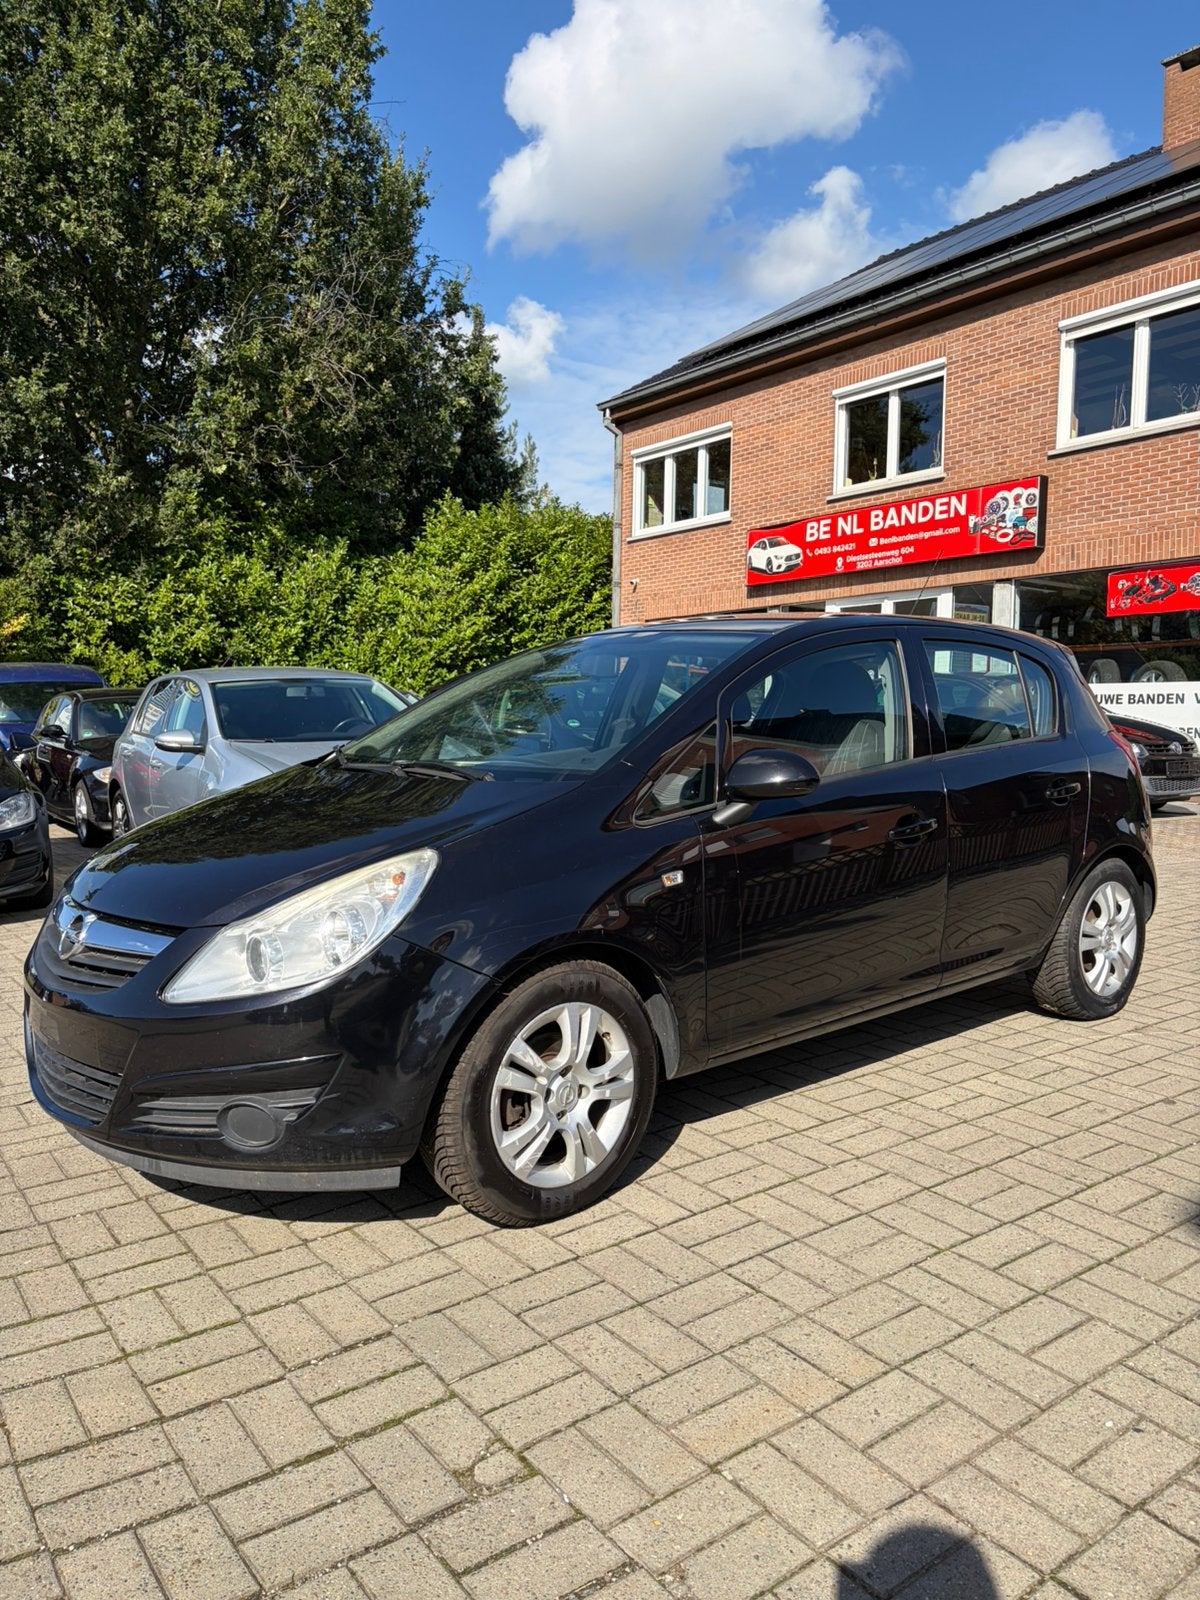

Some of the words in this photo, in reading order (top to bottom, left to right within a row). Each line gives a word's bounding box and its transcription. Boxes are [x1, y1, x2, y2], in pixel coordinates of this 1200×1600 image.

[805, 518, 831, 542] BE
[837, 513, 864, 537] NL
[870, 494, 967, 531] BANDEN
[879, 526, 960, 545] Benlbanden@gmail.com
[814, 545, 831, 556] 0493
[1127, 693, 1185, 705] BANDEN
